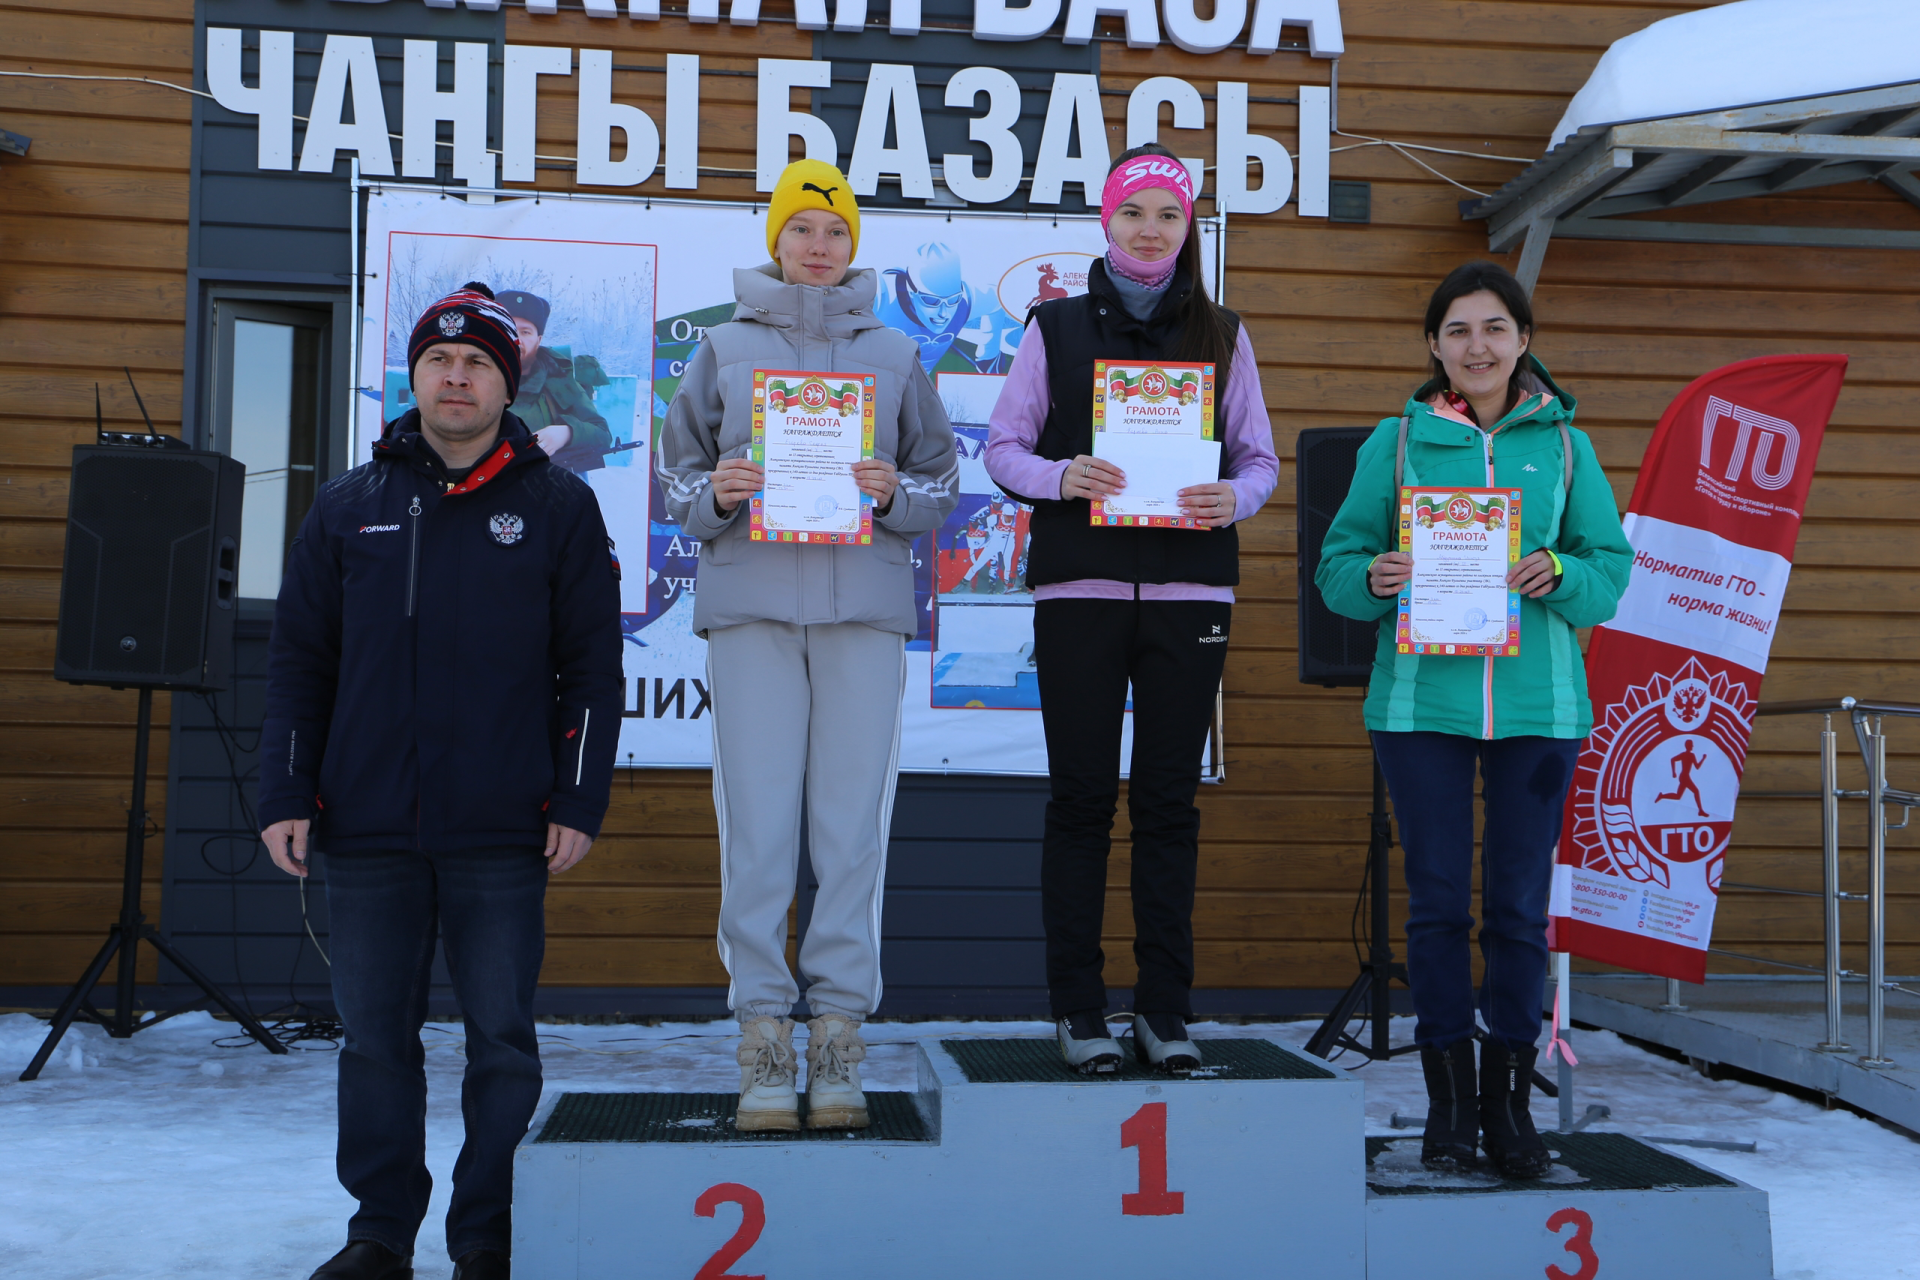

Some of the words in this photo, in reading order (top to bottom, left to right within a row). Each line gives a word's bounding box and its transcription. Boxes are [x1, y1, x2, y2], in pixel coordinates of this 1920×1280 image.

[206, 27, 700, 204] ЧАҢГЫ
[756, 57, 1331, 217] БАЗАСЫ
[1063, 272, 1088, 280] АЛЕКС
[670, 318, 707, 342] От
[786, 416, 841, 427] ГРАМОТА
[1126, 406, 1181, 416] ГРАМОТА
[1700, 395, 1800, 490] ГТО
[360, 525, 400, 533] FORWARD
[1433, 531, 1487, 541] ГРАМОТА
[664, 534, 702, 557] Ал
[1632, 550, 1724, 586] Норматив
[1726, 575, 1756, 596] ГТО
[663, 577, 697, 599] уч
[1667, 593, 1725, 616] норма
[1725, 608, 1772, 635] жизни!
[621, 677, 712, 720] ШИХ
[1661, 826, 1715, 854] ГТО
[1572, 882, 1628, 901] -800-350-00-00
[1120, 1102, 1185, 1216] 1
[694, 1182, 766, 1280] 2
[1545, 1207, 1599, 1280] 3
